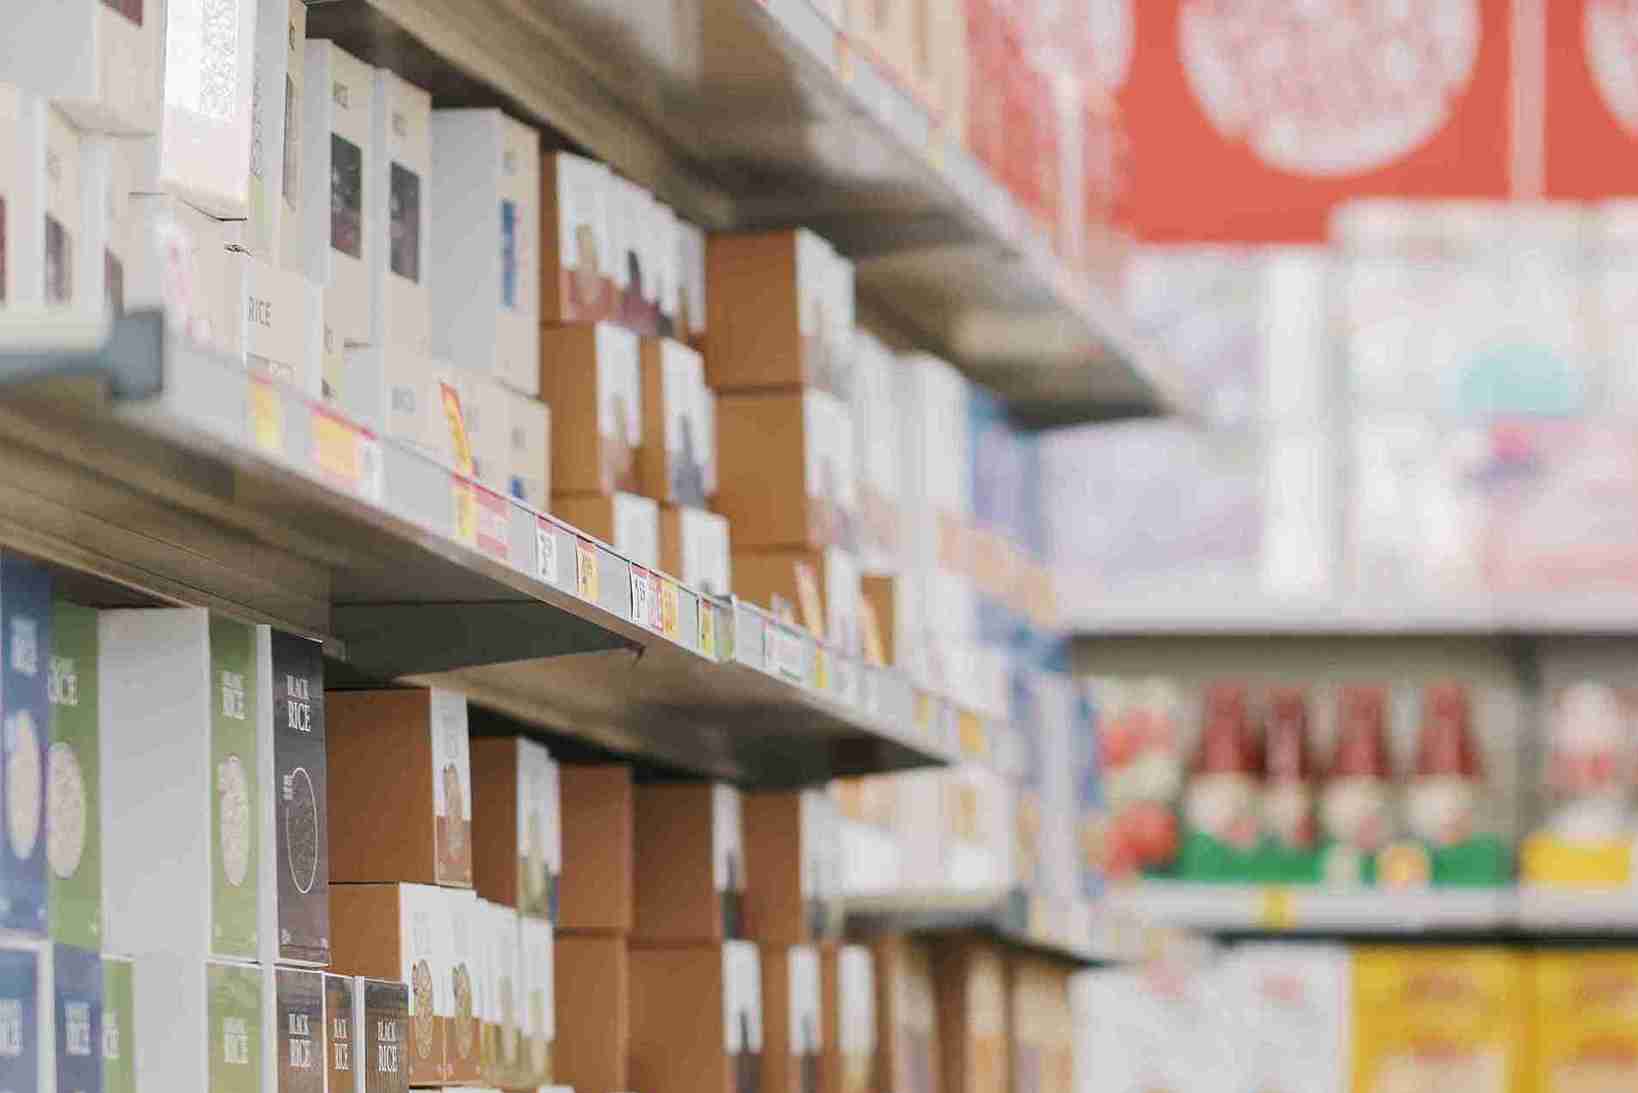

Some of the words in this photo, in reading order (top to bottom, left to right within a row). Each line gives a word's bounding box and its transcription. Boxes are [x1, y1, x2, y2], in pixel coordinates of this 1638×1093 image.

[247, 296, 272, 328] RICE
[287, 701, 311, 733] RICE
[290, 1039, 312, 1068] RICE
[378, 1044, 399, 1072] RICE
